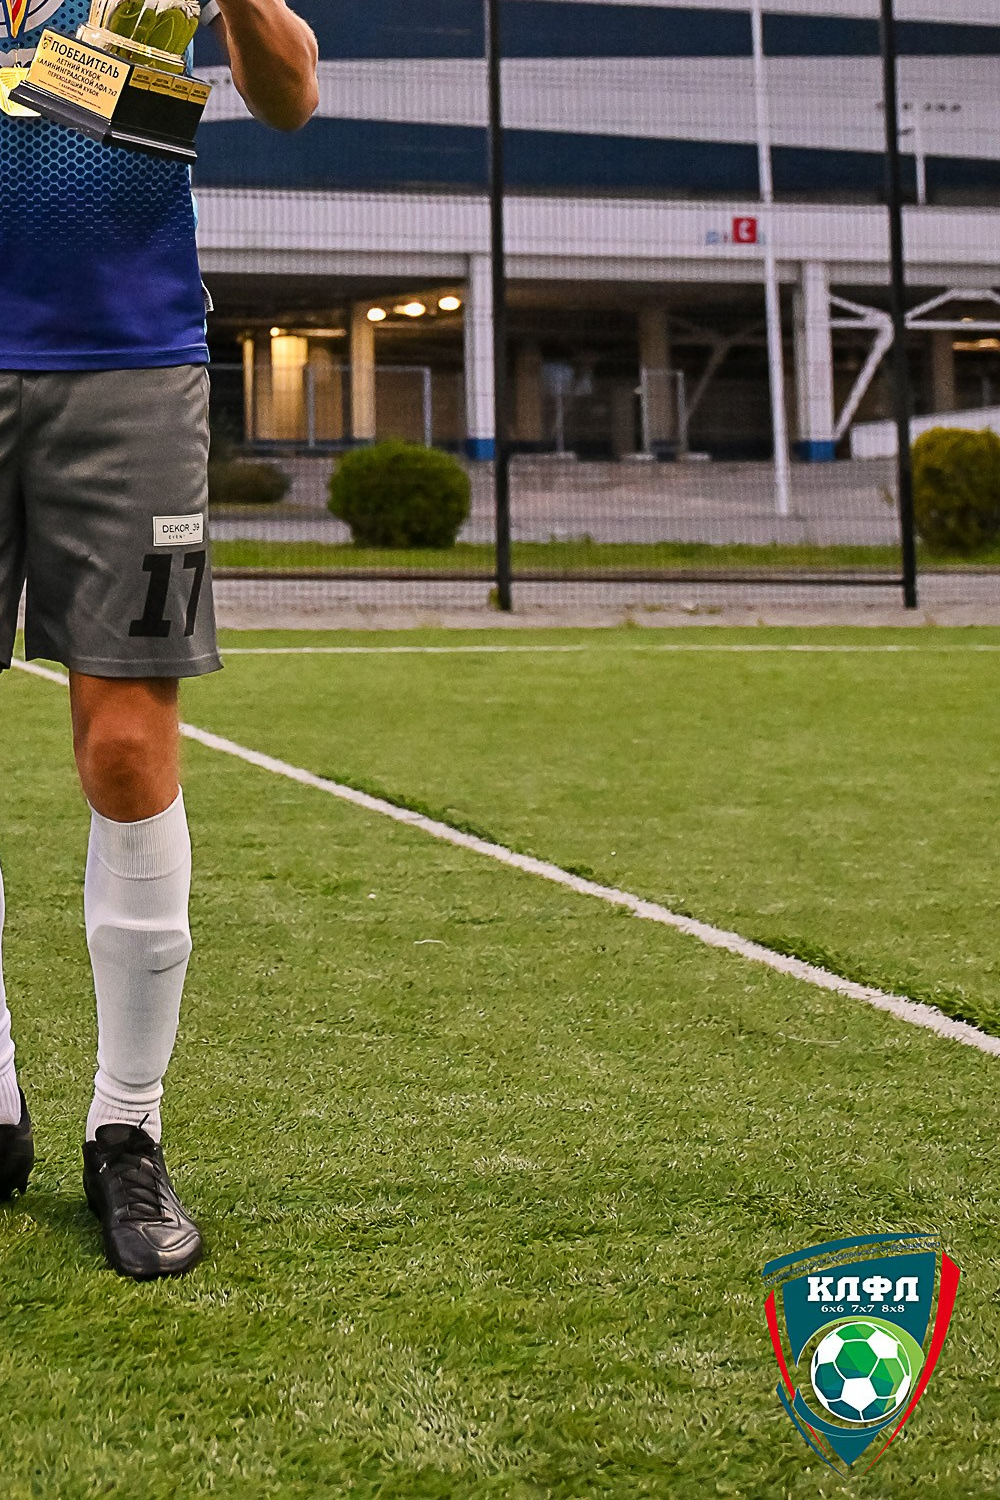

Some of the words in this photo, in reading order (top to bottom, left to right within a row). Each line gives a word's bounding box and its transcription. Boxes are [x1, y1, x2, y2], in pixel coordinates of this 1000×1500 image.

[50, 40, 120, 79] ПОБЕДИТЕЛЬ
[56, 57, 81, 72] ЛЕТНИЙ
[81, 66, 102, 81] КУБОК
[83, 84, 100, 97] КУБОК
[128, 550, 206, 638] 17
